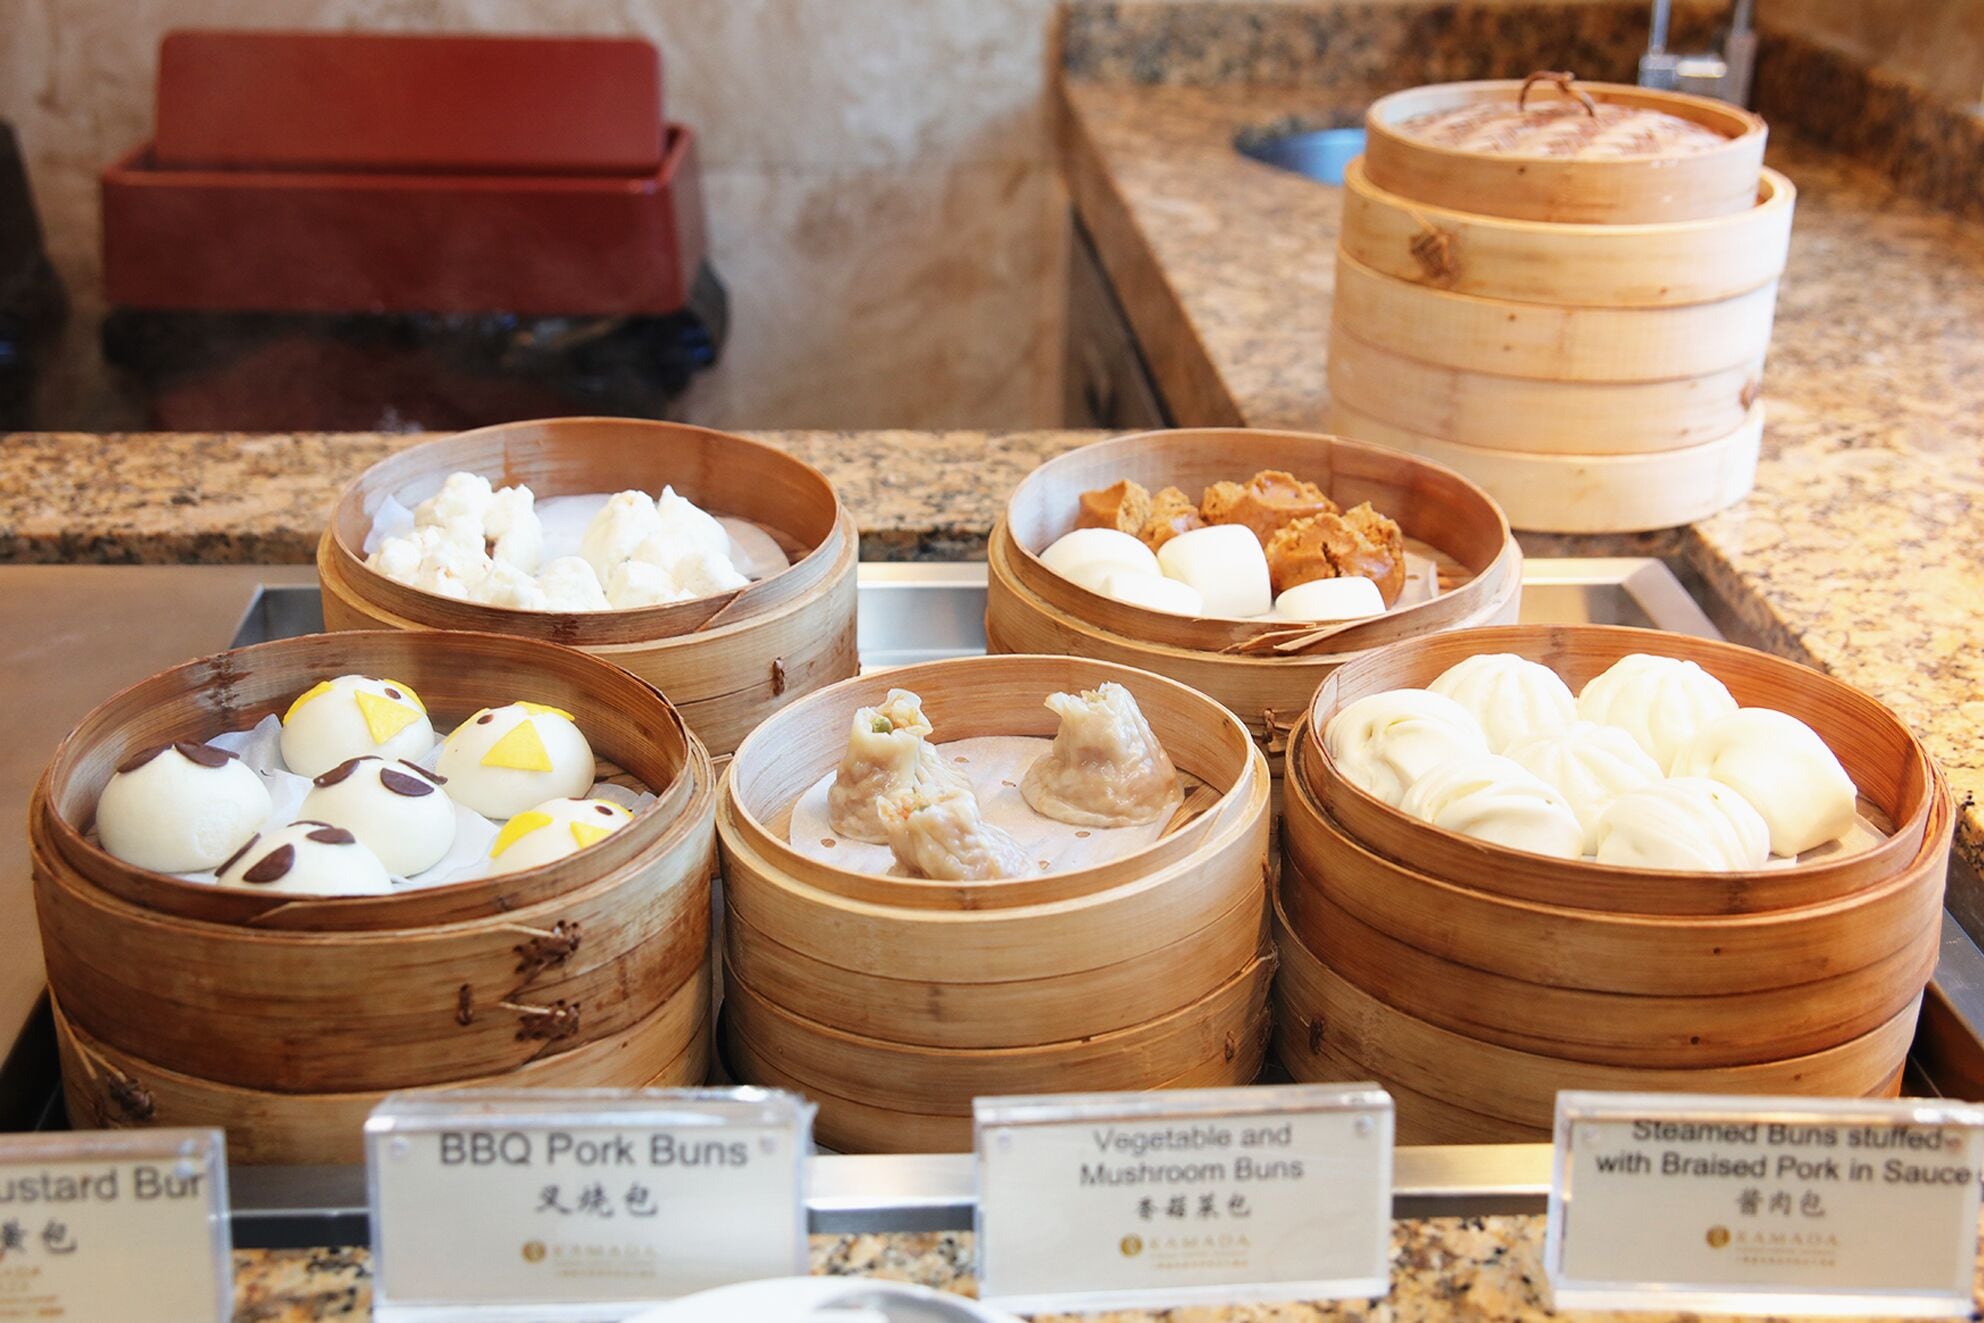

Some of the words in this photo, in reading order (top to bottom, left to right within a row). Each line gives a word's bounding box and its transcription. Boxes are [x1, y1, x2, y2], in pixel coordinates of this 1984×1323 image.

[441, 1132, 532, 1166] BBQ
[547, 1133, 636, 1166] Pork
[651, 1134, 749, 1167] Buns
[1093, 1127, 1231, 1156] Vegetable
[1241, 1124, 1292, 1147] and
[1632, 1119, 1758, 1145] Steamed
[1767, 1123, 1838, 1148] Buns
[1848, 1127, 1943, 1151] stuffed
[1080, 1164, 1225, 1187] Mushroom
[1234, 1157, 1303, 1181] Buns
[1596, 1151, 1651, 1175] with
[1661, 1153, 1767, 1179] Braised
[1777, 1157, 1839, 1181] Pork
[1849, 1160, 1874, 1182] in
[1882, 1160, 1971, 1185] Sauce
